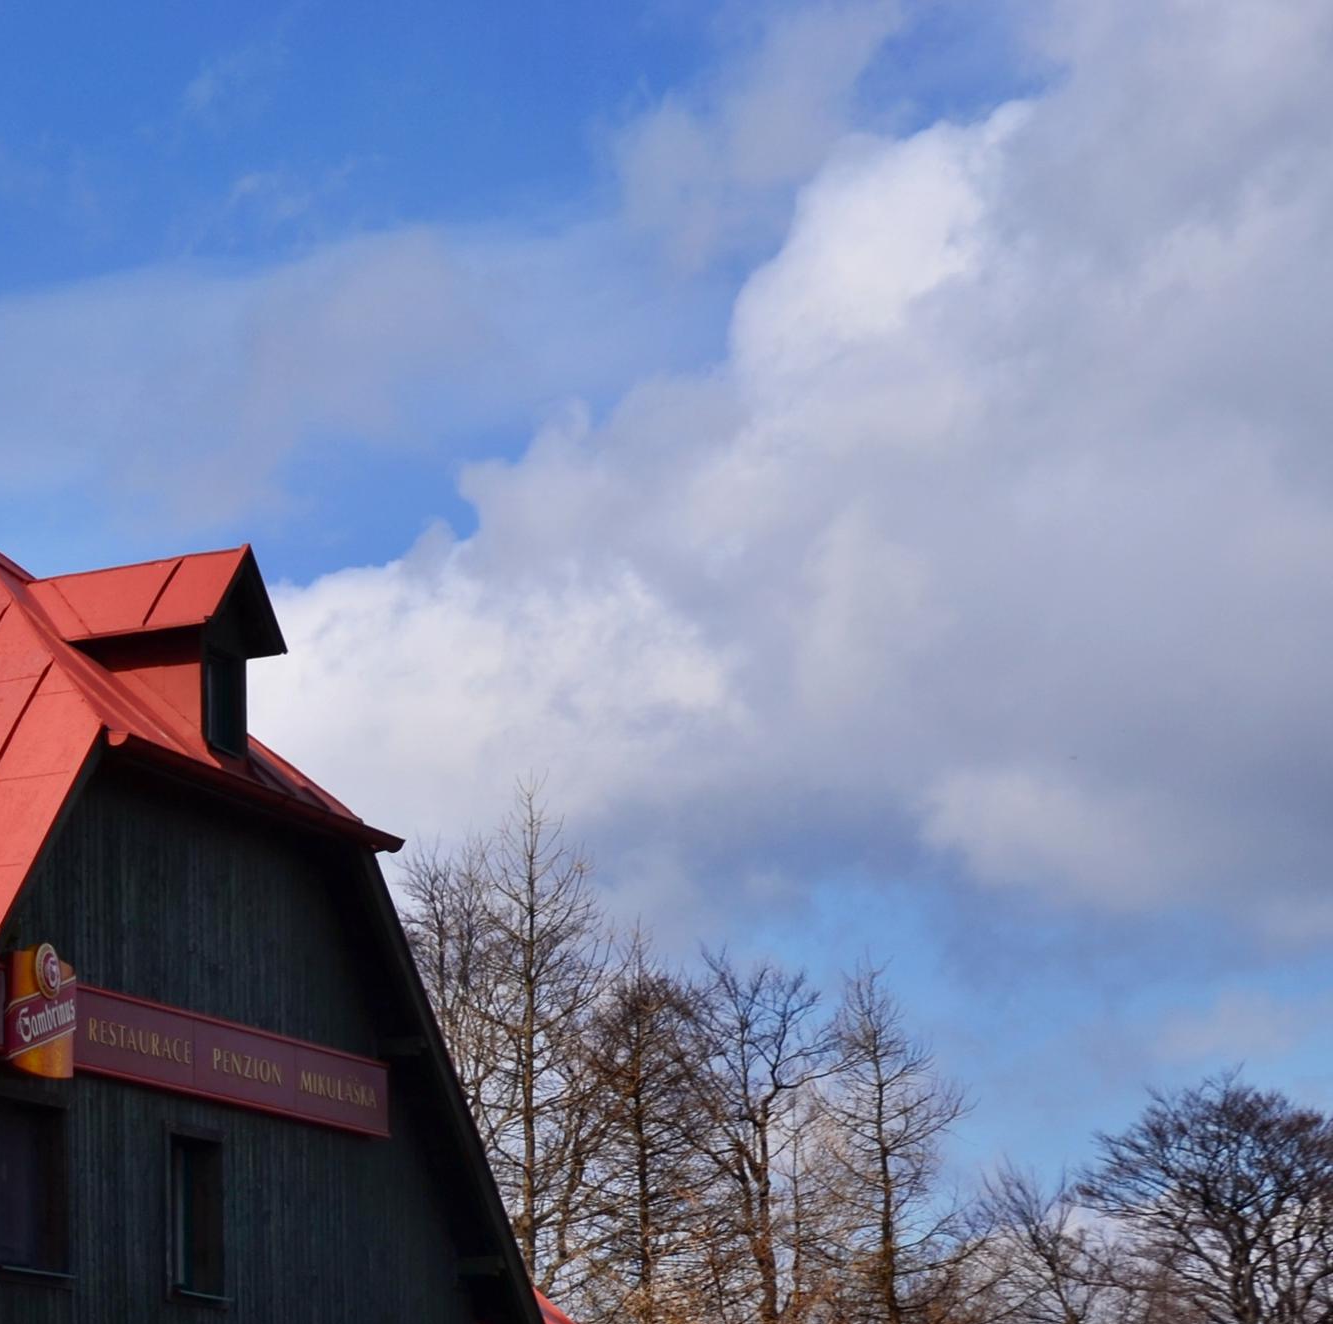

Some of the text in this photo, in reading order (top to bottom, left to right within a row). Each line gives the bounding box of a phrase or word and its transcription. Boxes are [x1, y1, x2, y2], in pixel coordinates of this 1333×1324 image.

[17, 998, 76, 1043] Gambrinus
[88, 1016, 191, 1065] RESTAURACE
[213, 1047, 283, 1086] PENZION
